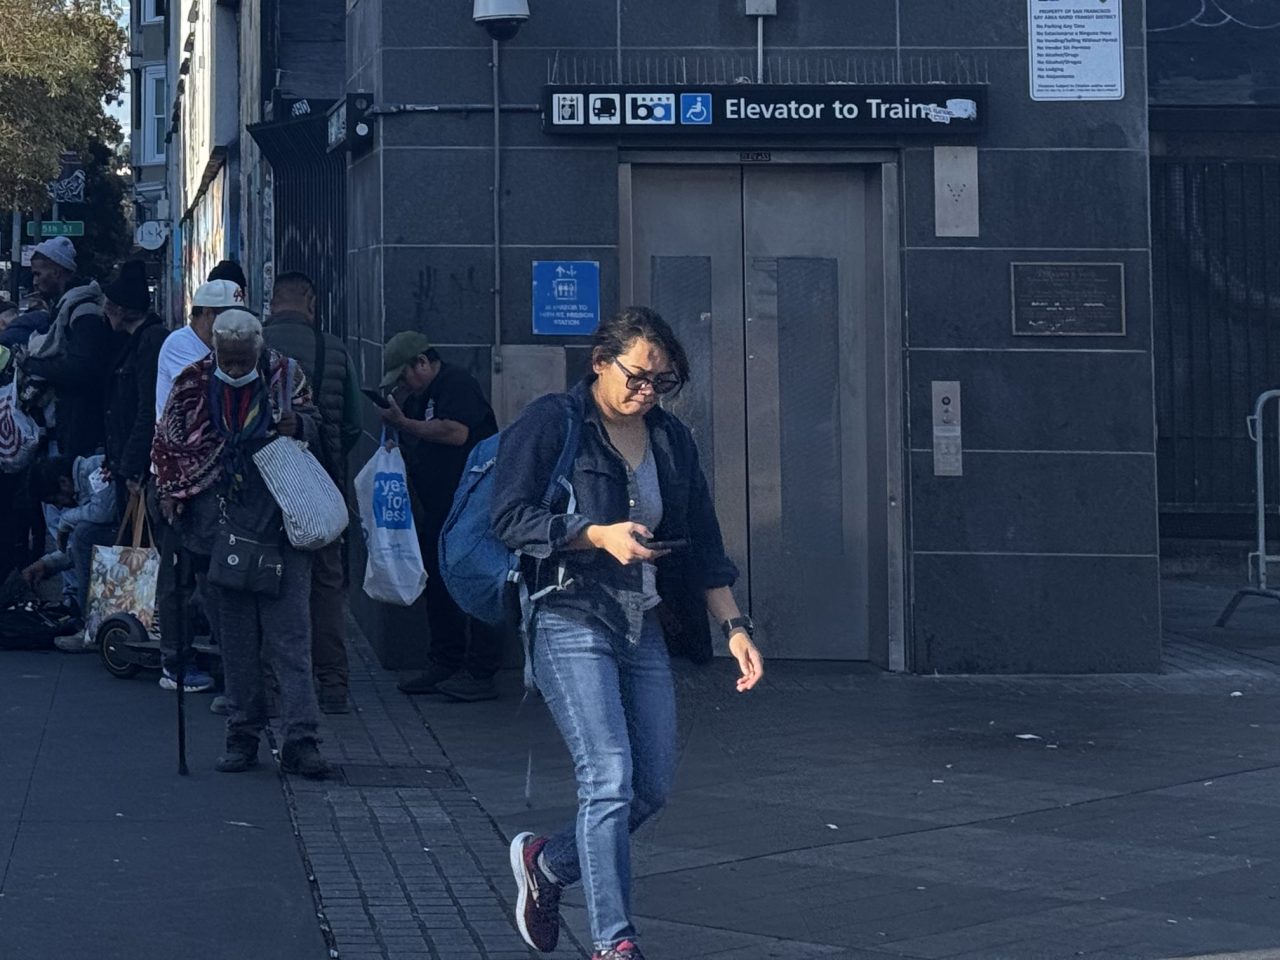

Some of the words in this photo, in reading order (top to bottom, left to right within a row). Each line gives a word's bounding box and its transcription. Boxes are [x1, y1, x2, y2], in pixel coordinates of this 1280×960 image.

[725, 98, 824, 119] Elevator
[833, 100, 859, 119] to
[42, 224, 58, 233] 5th
[382, 507, 407, 521] less
